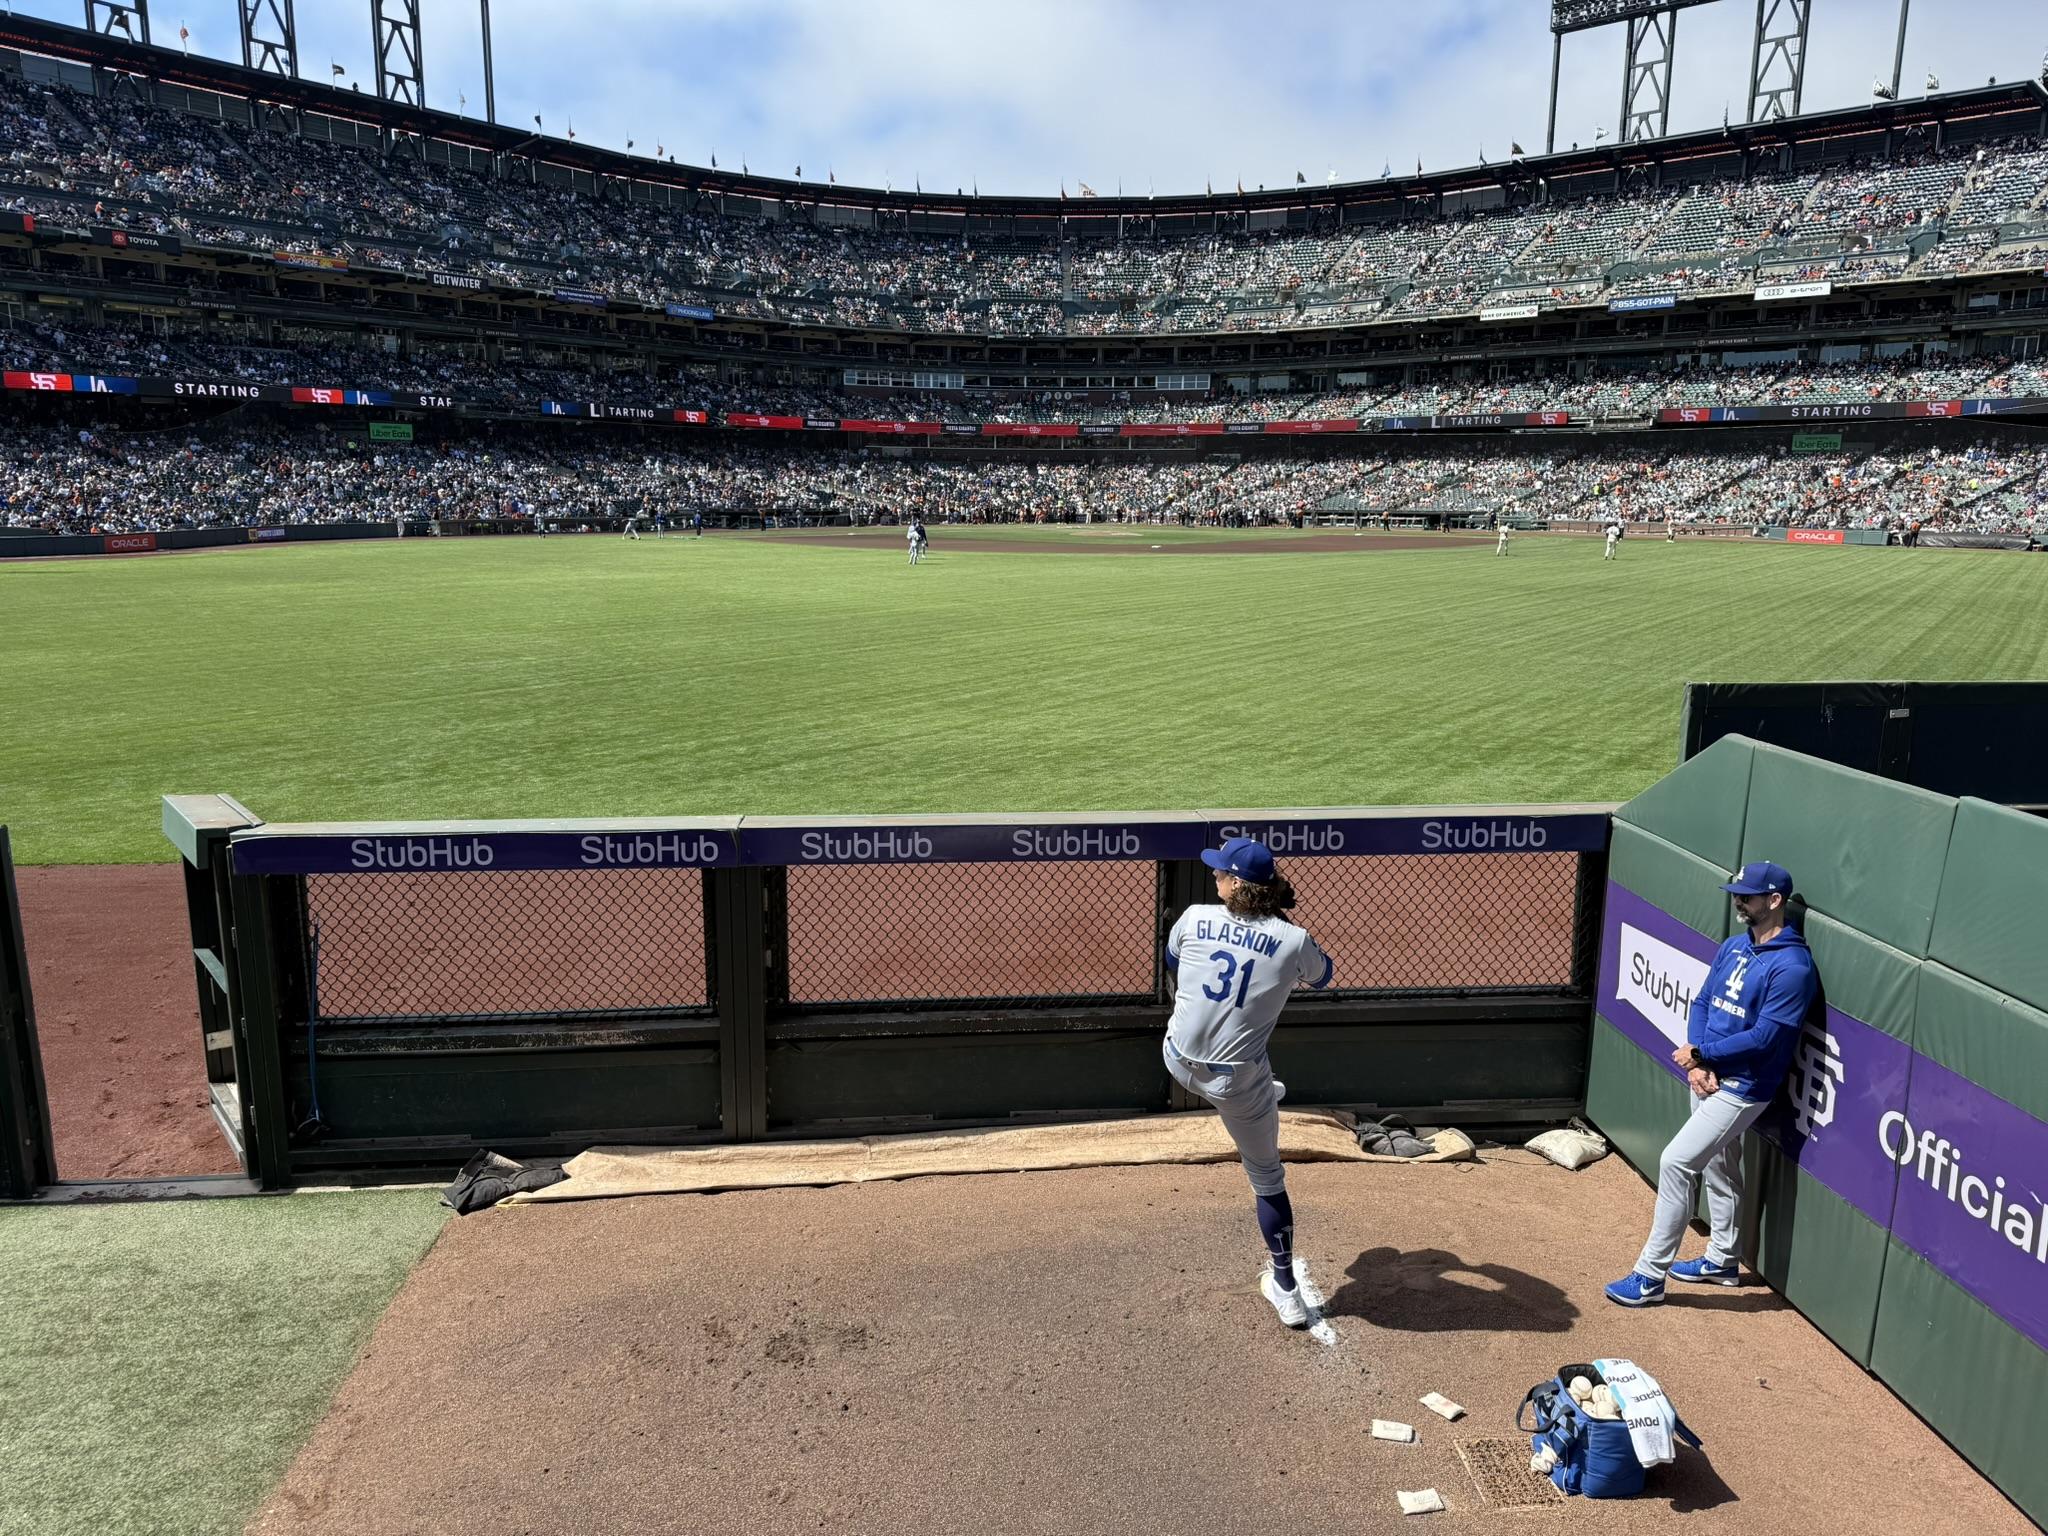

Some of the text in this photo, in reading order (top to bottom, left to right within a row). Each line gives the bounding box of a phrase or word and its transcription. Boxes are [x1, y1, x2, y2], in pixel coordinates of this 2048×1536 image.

[128, 236, 159, 247] TOYOTA
[433, 273, 481, 290] CUTWATER
[1790, 286, 1823, 294] e-tron
[1618, 296, 1674, 309] 855-GOT-PAIN
[174, 382, 260, 398] STARTING
[609, 406, 655, 418] TARTING
[1791, 405, 1873, 417] STARTING
[1451, 416, 1502, 426] TARTING
[372, 429, 411, 439] Uber Eats
[1794, 440, 1839, 450] Uber Eats
[111, 537, 149, 549] ORACLE
[1794, 532, 1837, 541] ORACLE
[1012, 828, 1141, 856] StubHub
[1421, 820, 1547, 849] StubHub
[351, 837, 493, 868] StubHub
[580, 834, 719, 864] StubHub
[800, 831, 933, 860] StubHub
[1197, 919, 1282, 959] GLASNOW
[1202, 950, 1256, 1010] 31
[1630, 951, 1691, 1021] StubH
[1878, 1110, 2048, 1264] Official
